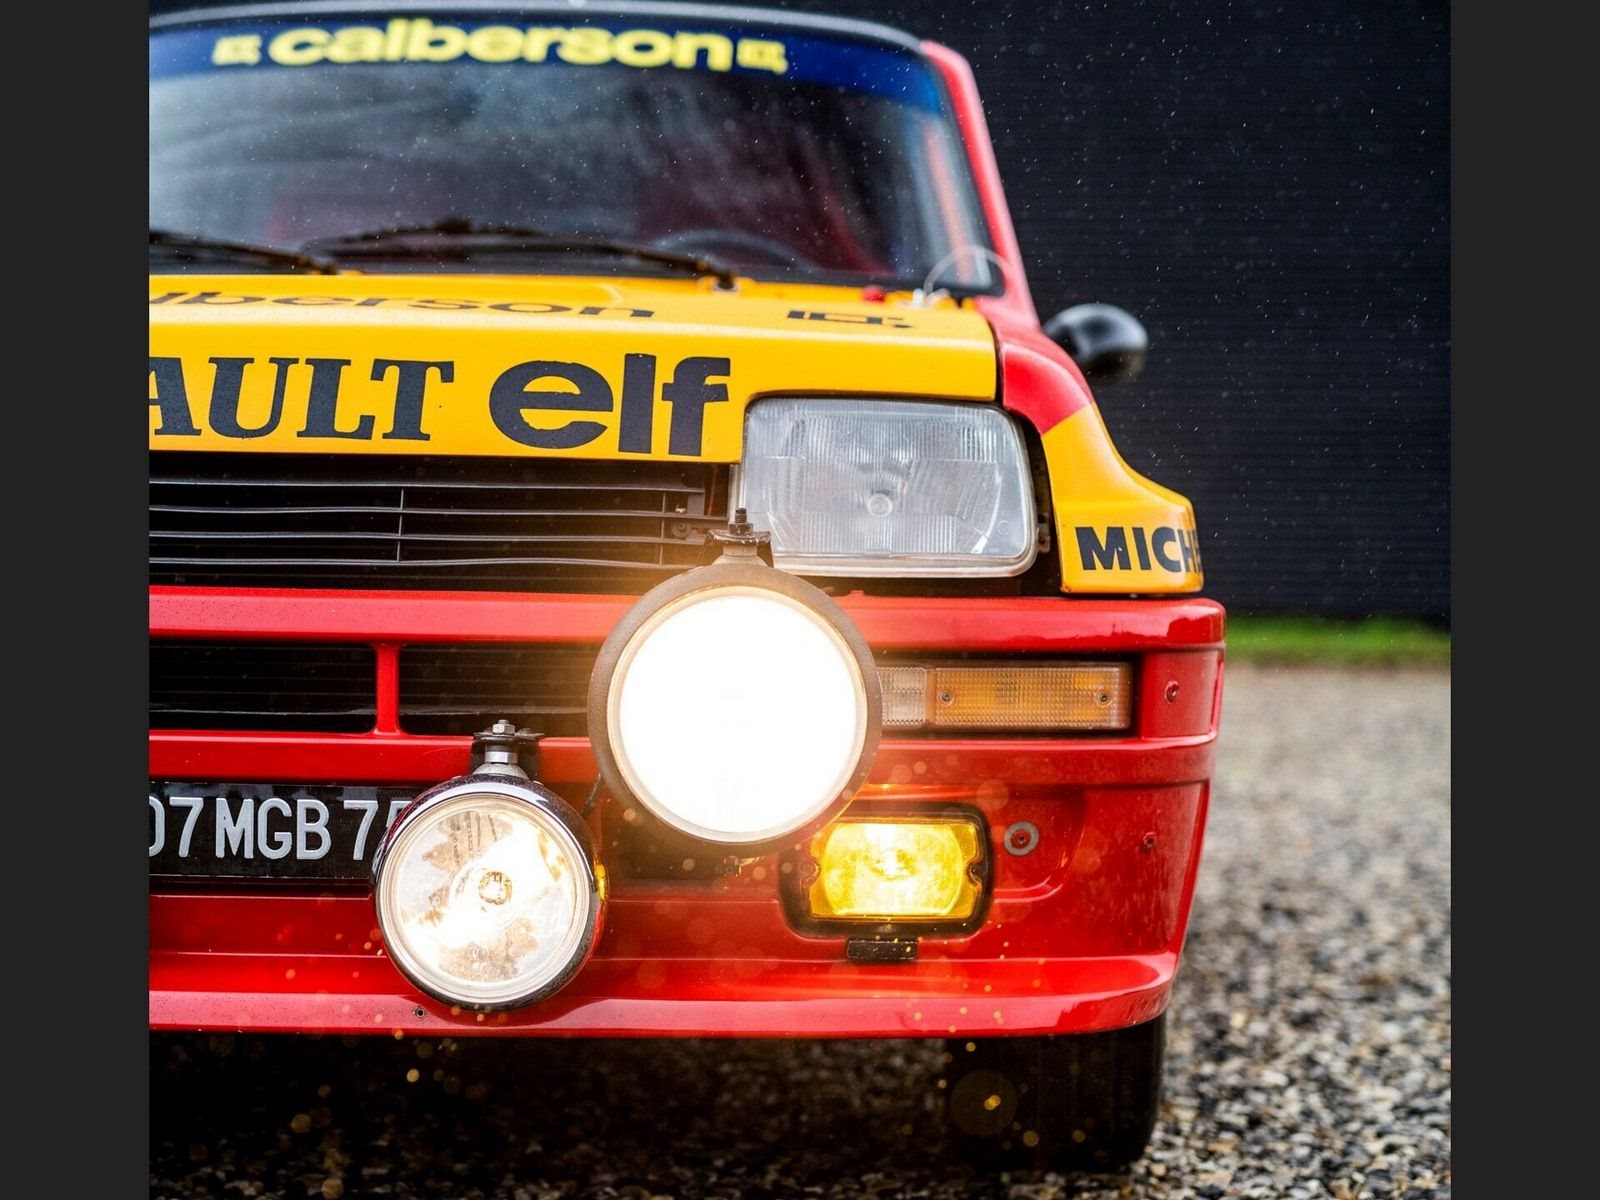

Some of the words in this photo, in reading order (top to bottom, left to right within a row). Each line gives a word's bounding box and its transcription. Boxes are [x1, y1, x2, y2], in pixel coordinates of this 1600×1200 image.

[268, 19, 735, 73] calberson
[149, 356, 455, 441] AULT
[489, 353, 731, 457] elf
[215, 797, 331, 860] MGB
